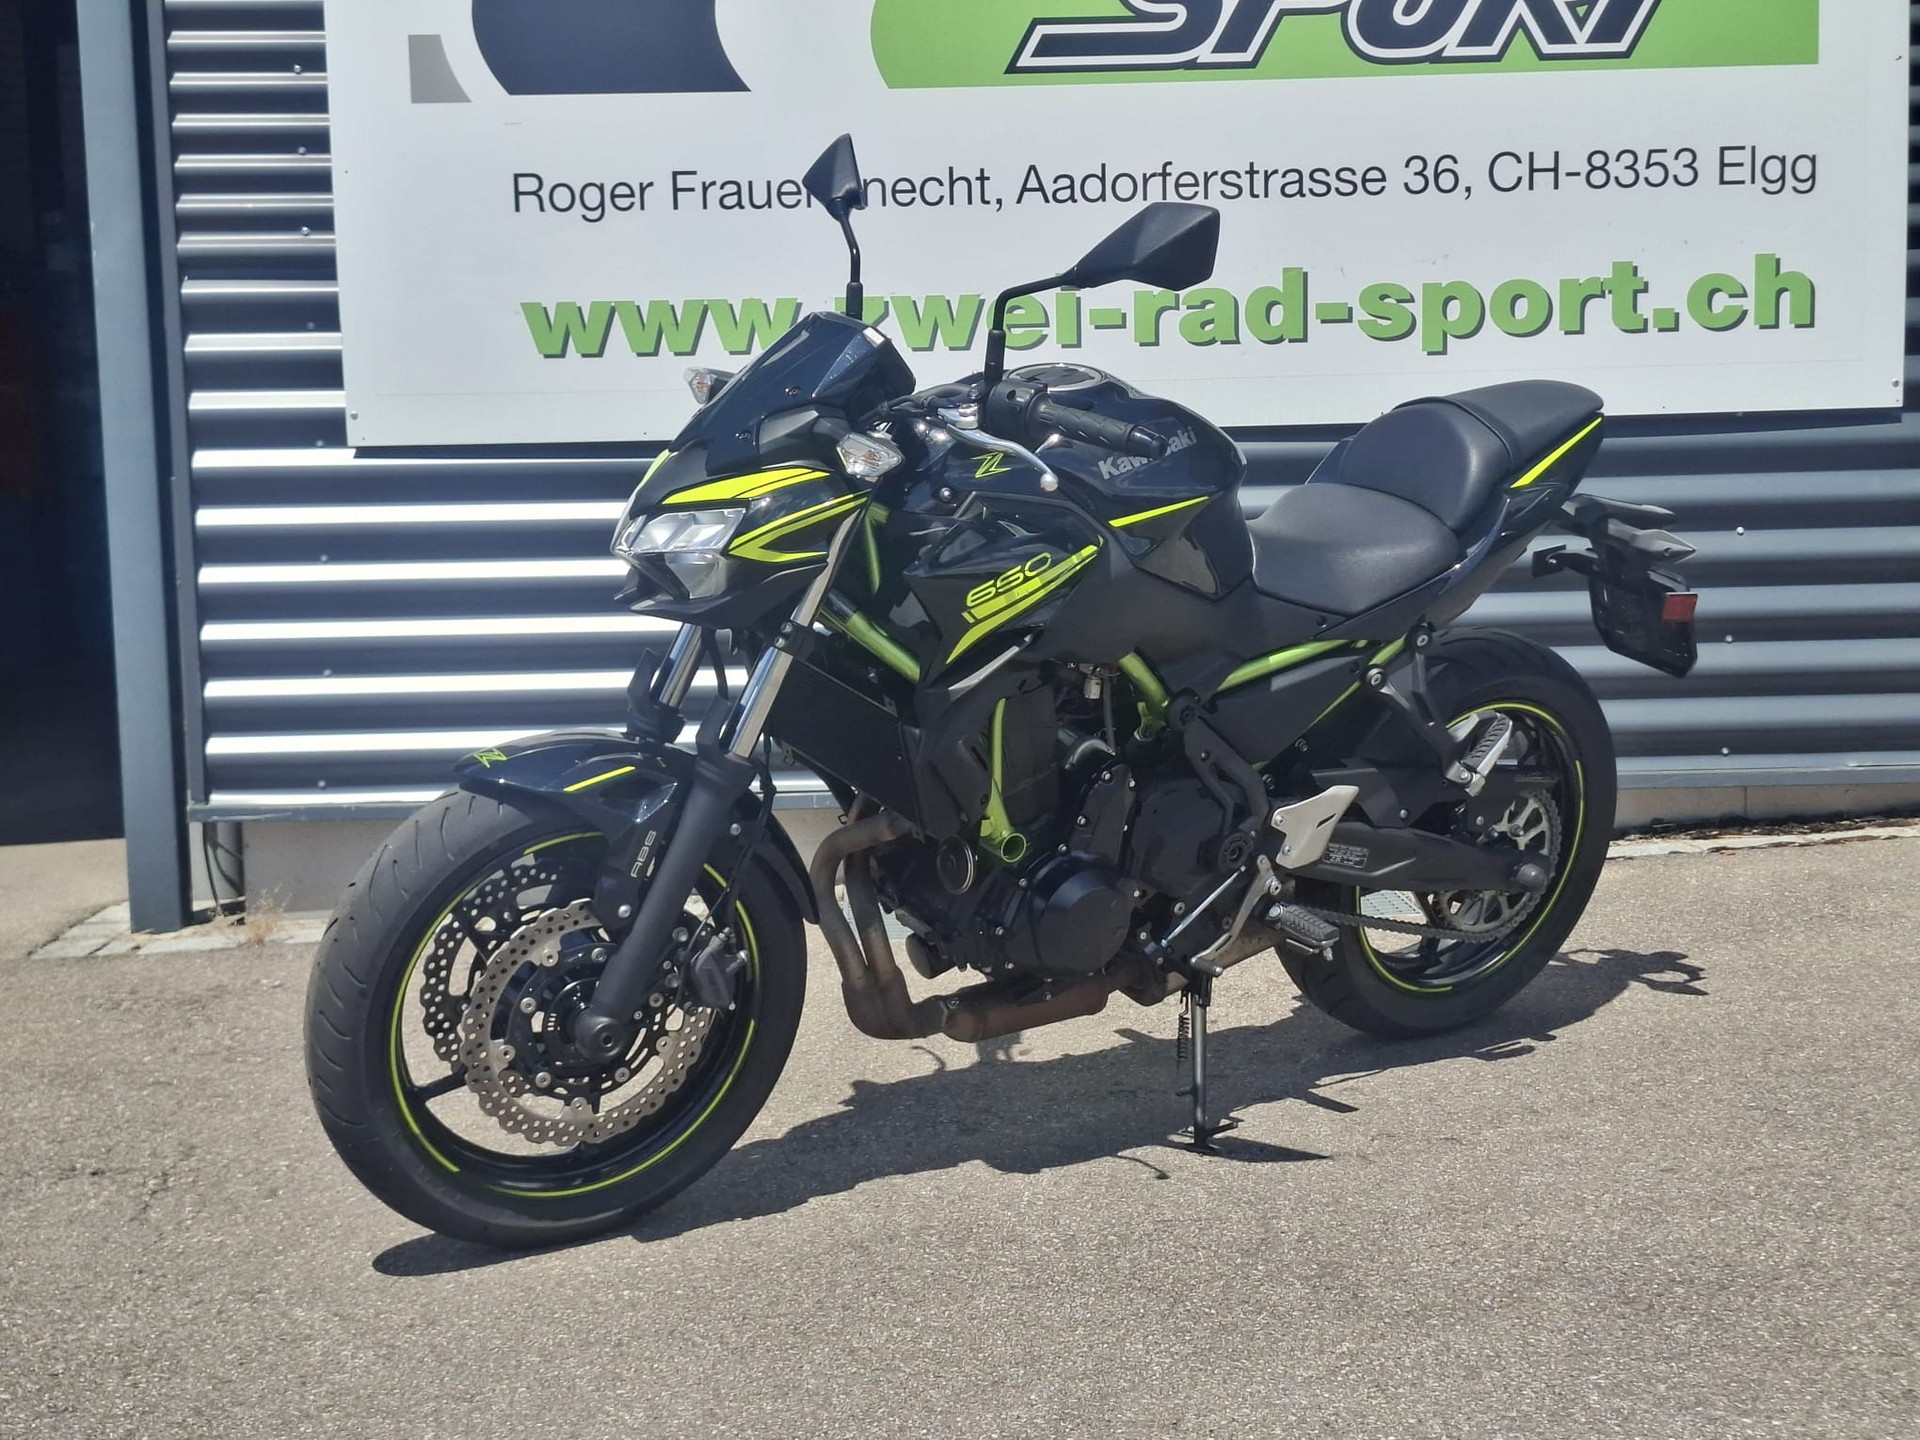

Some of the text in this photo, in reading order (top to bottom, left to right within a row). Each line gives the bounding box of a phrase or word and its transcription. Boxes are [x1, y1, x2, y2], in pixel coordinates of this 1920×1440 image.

[514, 145, 1817, 223] Roger Frauenecht, Aadorferstrasse 36, CH-8353 Elgg
[521, 253, 1815, 358] wwwwei-rad-sport.ch
[1098, 426, 1197, 480] Kawaki
[966, 552, 1051, 607] 650
[630, 830, 656, 878] ABS
